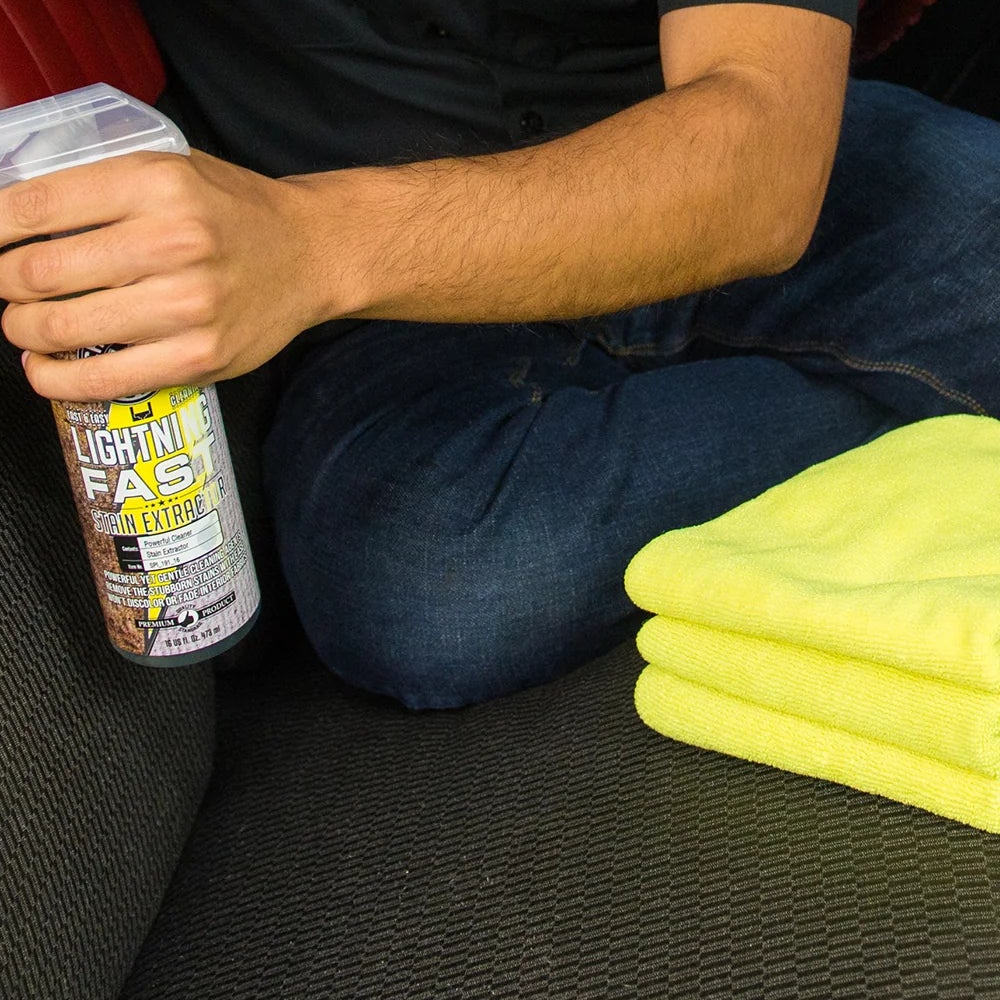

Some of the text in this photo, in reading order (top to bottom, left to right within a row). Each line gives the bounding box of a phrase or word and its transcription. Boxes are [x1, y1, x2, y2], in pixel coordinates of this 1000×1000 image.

[70, 392, 212, 467] LIGHTNING
[80, 430, 216, 504] FAST
[91, 476, 228, 535] STAIN EXTRACTOR
[143, 530, 193, 548] Powerful Cleaner
[146, 543, 189, 558] Stain Extractor
[132, 586, 149, 597] THE
[149, 577, 193, 597] STUBBORN
[193, 565, 220, 587] STAINS
[140, 573, 156, 585] YET
[158, 566, 189, 583] GENTLE
[189, 549, 225, 574] CLEANING
[127, 598, 166, 608] DISCOLOR
[165, 595, 178, 606] OR
[179, 588, 200, 604] FADE
[199, 571, 231, 596] INTERIOR
[138, 593, 234, 628] PREMIUM PRODUCT
[173, 638, 182, 647] US
[200, 628, 213, 639] 473
